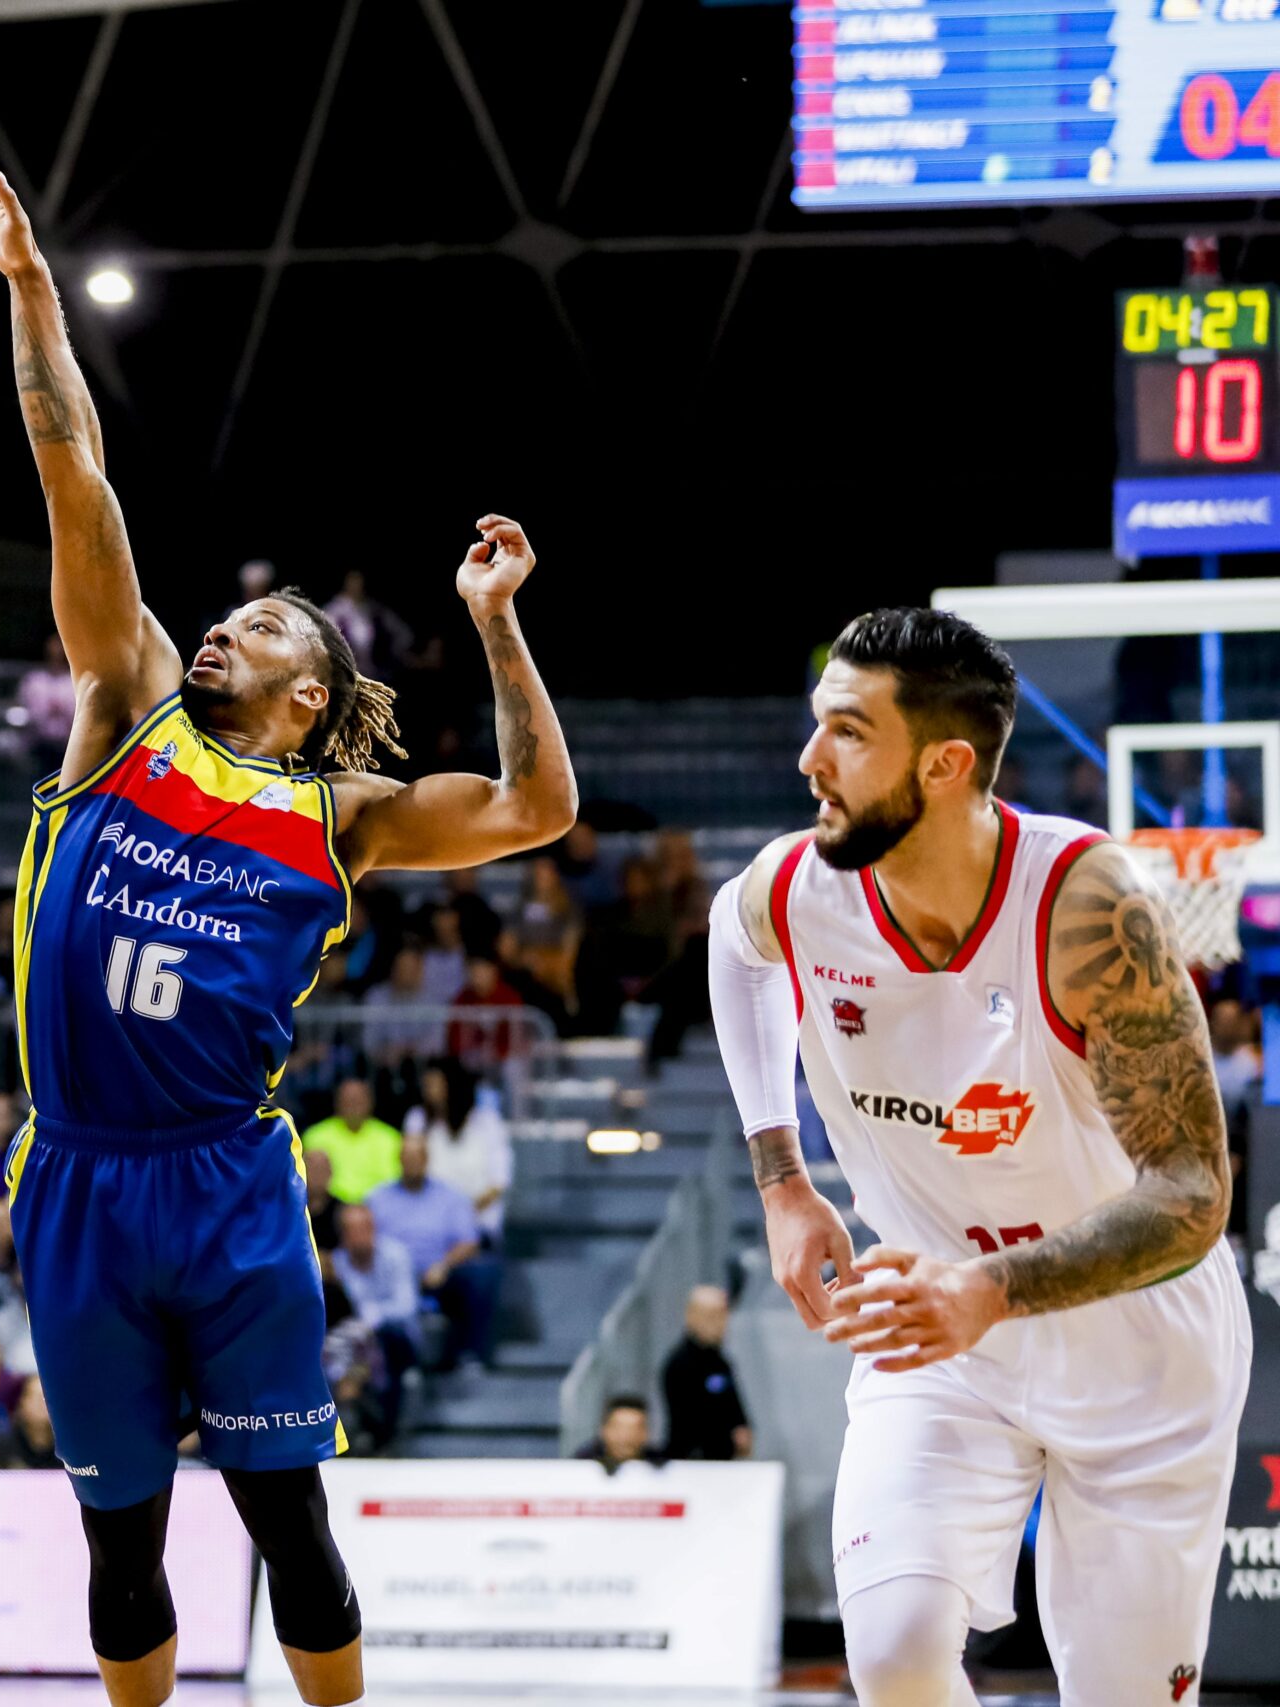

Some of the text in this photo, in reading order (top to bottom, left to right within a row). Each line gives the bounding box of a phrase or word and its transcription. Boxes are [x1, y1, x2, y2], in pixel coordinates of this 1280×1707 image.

[1124, 289, 1269, 352] 04:27
[1174, 358, 1261, 462] 10
[104, 884, 242, 942] Andorra
[105, 935, 188, 1021] 16
[814, 965, 876, 988] KELME
